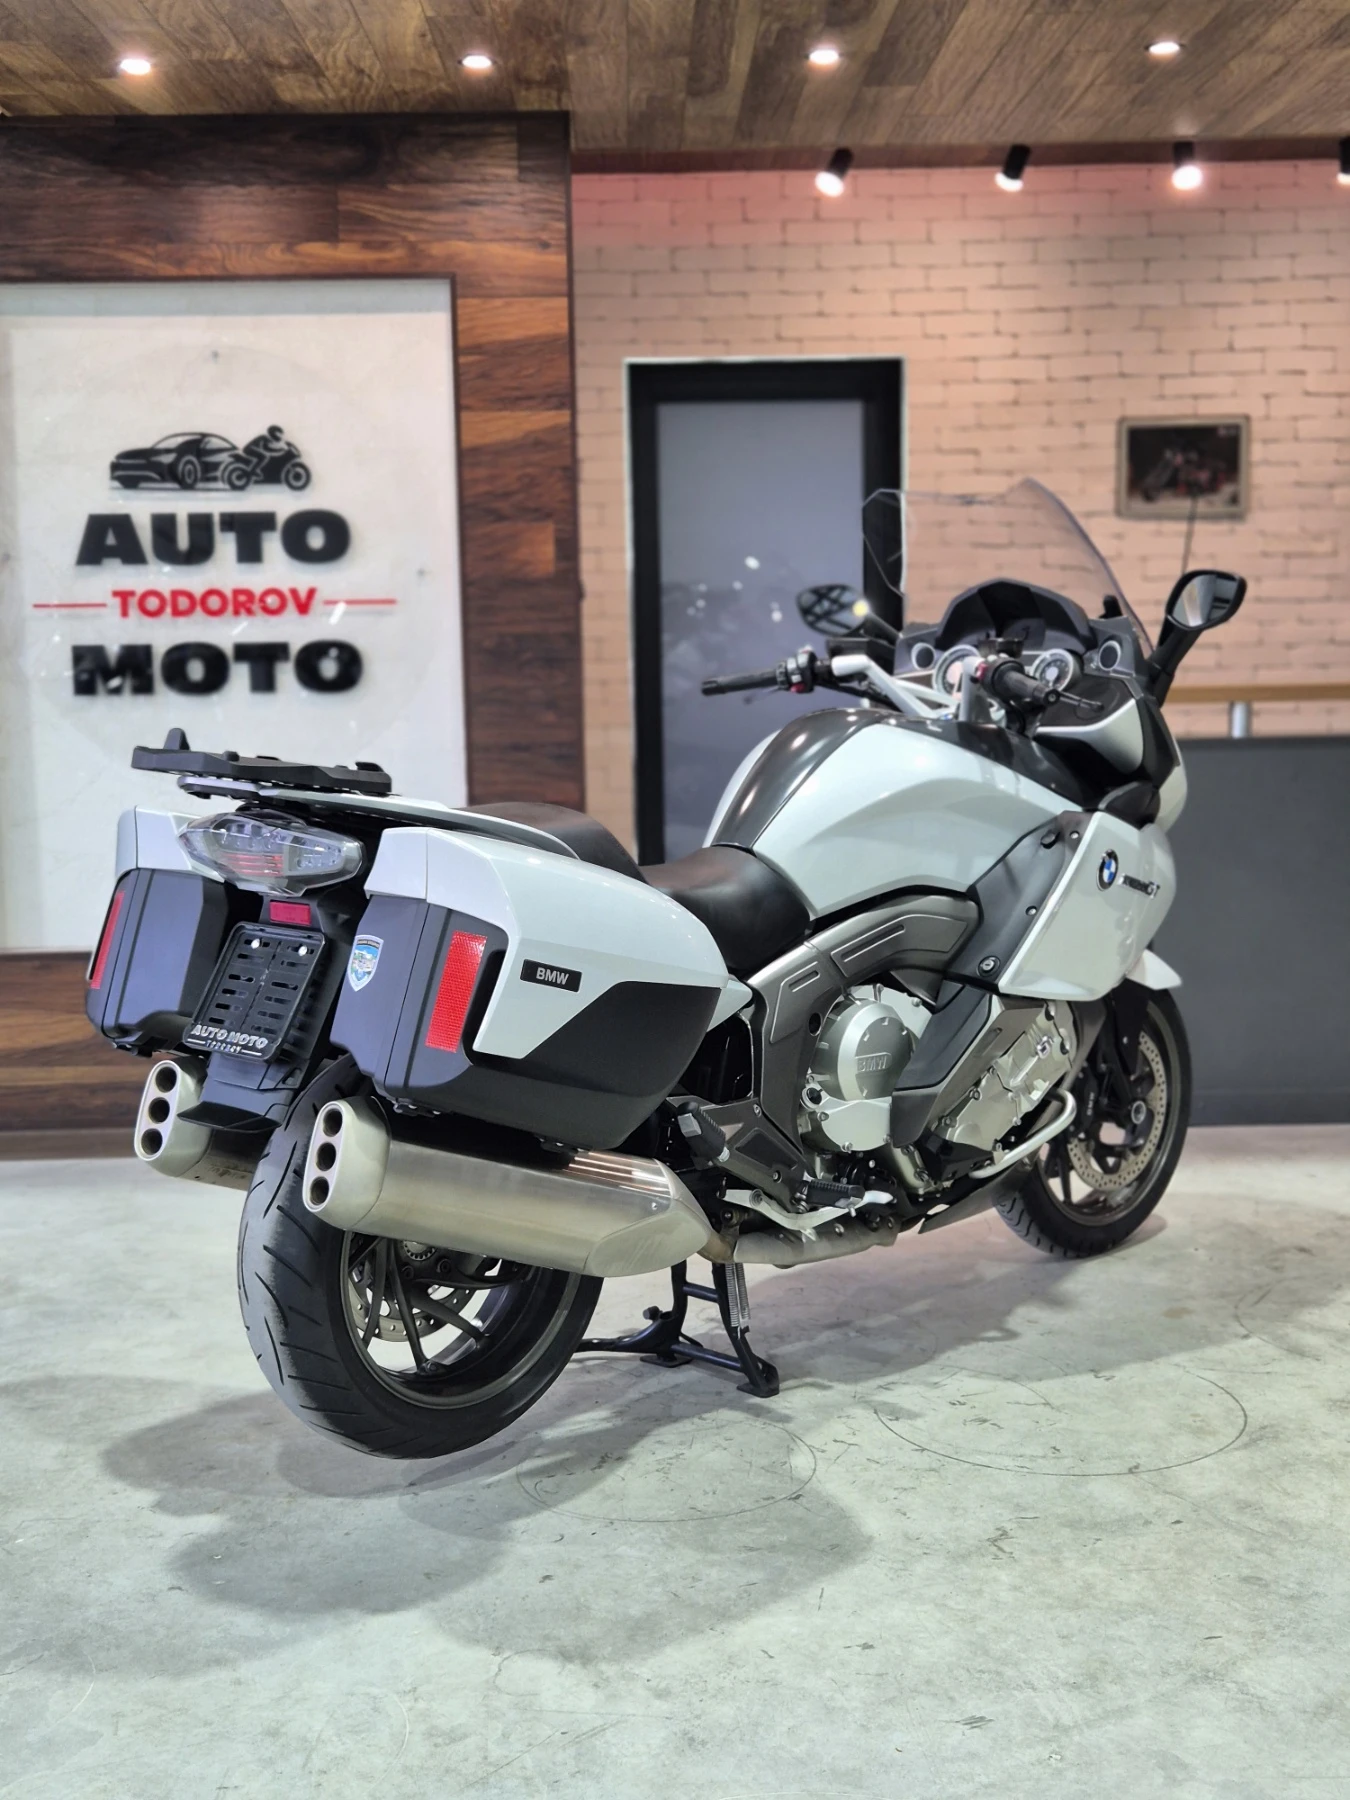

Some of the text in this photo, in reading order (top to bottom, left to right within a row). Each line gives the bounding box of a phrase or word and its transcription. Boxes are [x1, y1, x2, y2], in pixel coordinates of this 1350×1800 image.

[76, 509, 351, 565] AUTO
[112, 587, 318, 618] TODOROV
[71, 639, 363, 696] MOTO
[536, 967, 569, 985] BMW
[191, 1024, 228, 1040] AUTO
[226, 1031, 268, 1049] MOTO
